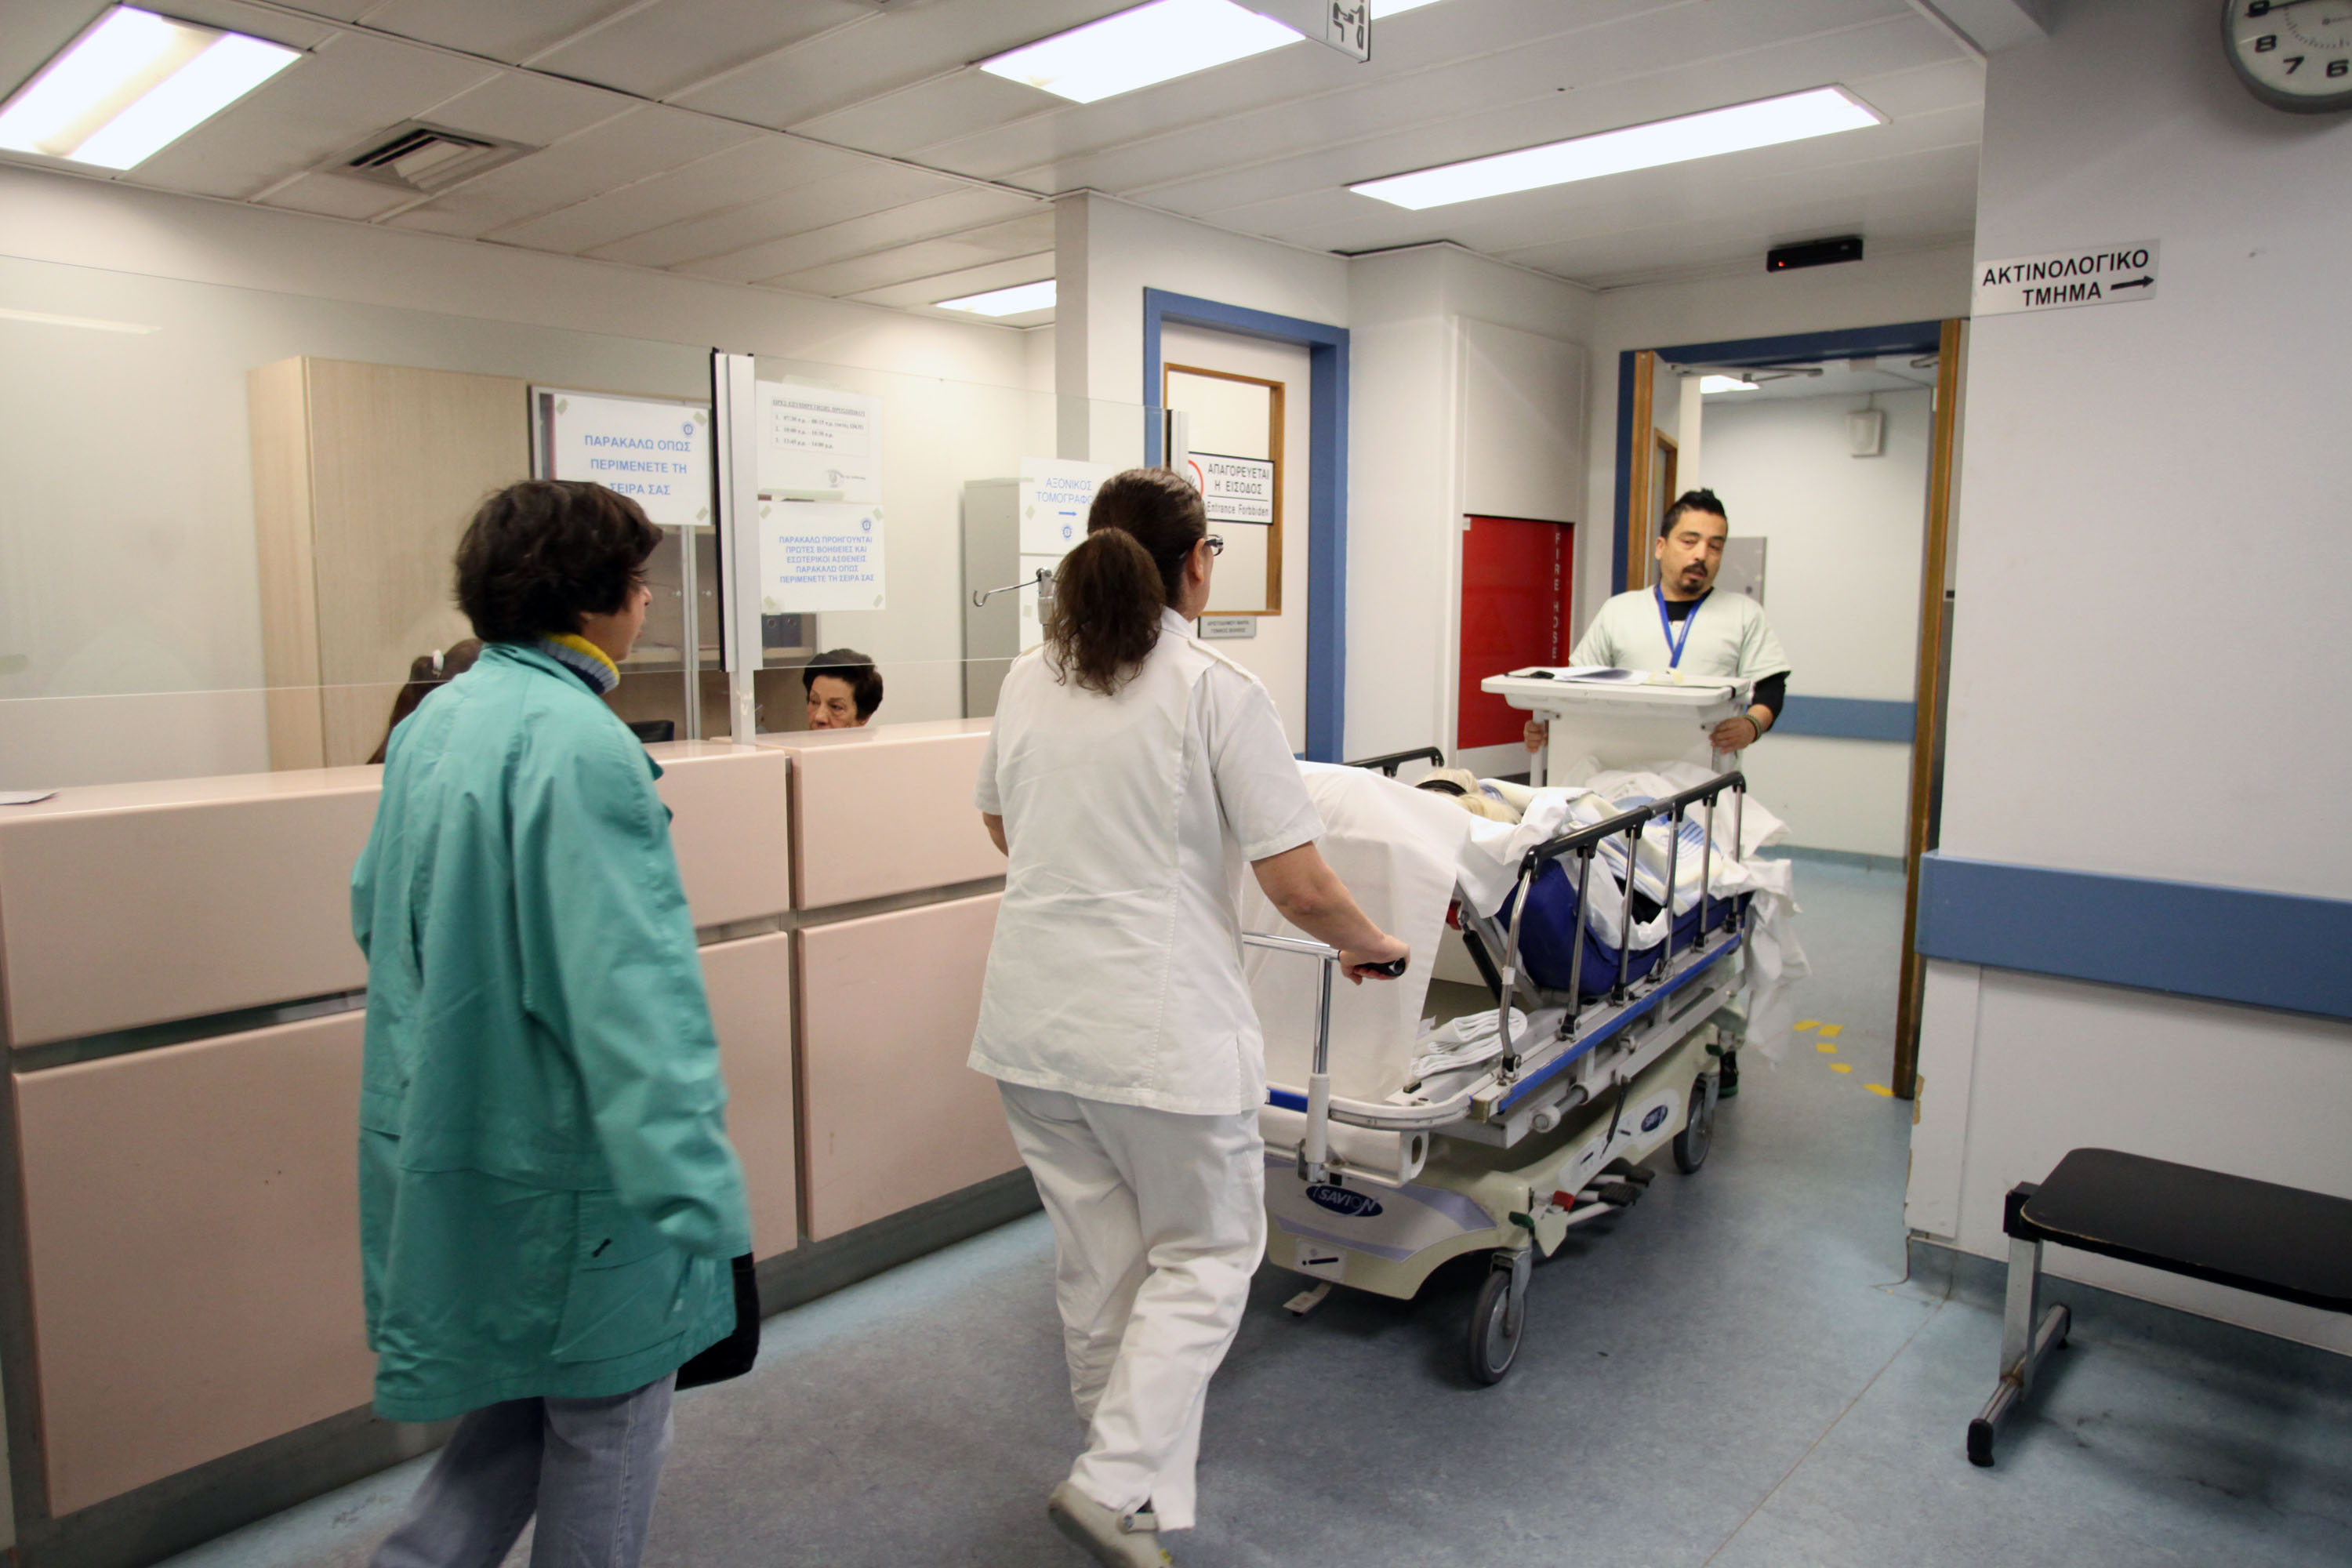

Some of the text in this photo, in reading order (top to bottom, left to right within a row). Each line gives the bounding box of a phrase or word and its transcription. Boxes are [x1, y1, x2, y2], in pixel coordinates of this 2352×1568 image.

[2256, 34, 2277, 53] 8
[2283, 56, 2304, 74] 7
[2327, 60, 2349, 78] 6
[1983, 249, 2149, 286] ΑΚΤΙΝΟΛΟΓΙΚΟ
[2022, 281, 2102, 307] ΤΜΗΜΑ
[584, 435, 691, 452] ΠΑΡΑΚΑΛΩ ΟΠΩΣ
[590, 459, 688, 474] ΠΕΡΙΜΕΝΕΤΕ ΤΗ
[1208, 463, 1269, 480] ΑΠΑΓΟΡΕΥΕΤΑΙ
[610, 482, 671, 495] ΣΕΙΡΑ ΣΑΣ
[1046, 477, 1092, 491] ΑΞΟΝΙΚΟΣ
[1214, 480, 1262, 495] Η ΕΙΣΟΔΟΣ
[1035, 491, 1095, 506] ΤΟΜΟΓΡΑΦΟ
[1207, 501, 1269, 516] Entrance Forbidden
